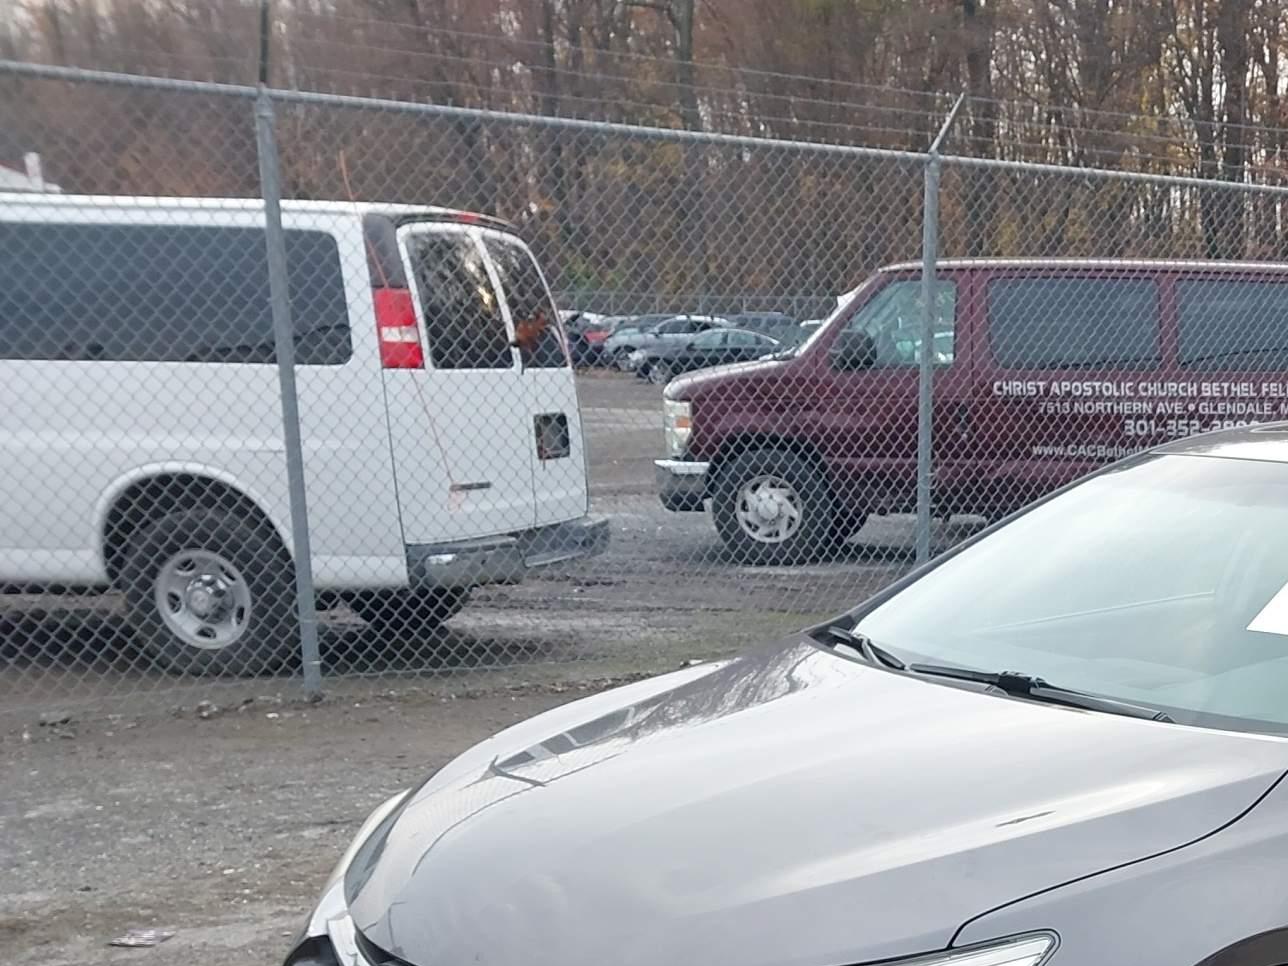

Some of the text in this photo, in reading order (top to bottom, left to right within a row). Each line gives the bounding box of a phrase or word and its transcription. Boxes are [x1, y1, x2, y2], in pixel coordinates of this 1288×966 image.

[993, 381, 1046, 396] CHRIST
[1049, 381, 1134, 396] APOSTOLIC
[1138, 382, 1197, 396] CHURCH
[1201, 382, 1257, 397] BETHEL
[1039, 402, 1071, 414] 7513
[1073, 402, 1152, 414] NORTHERN
